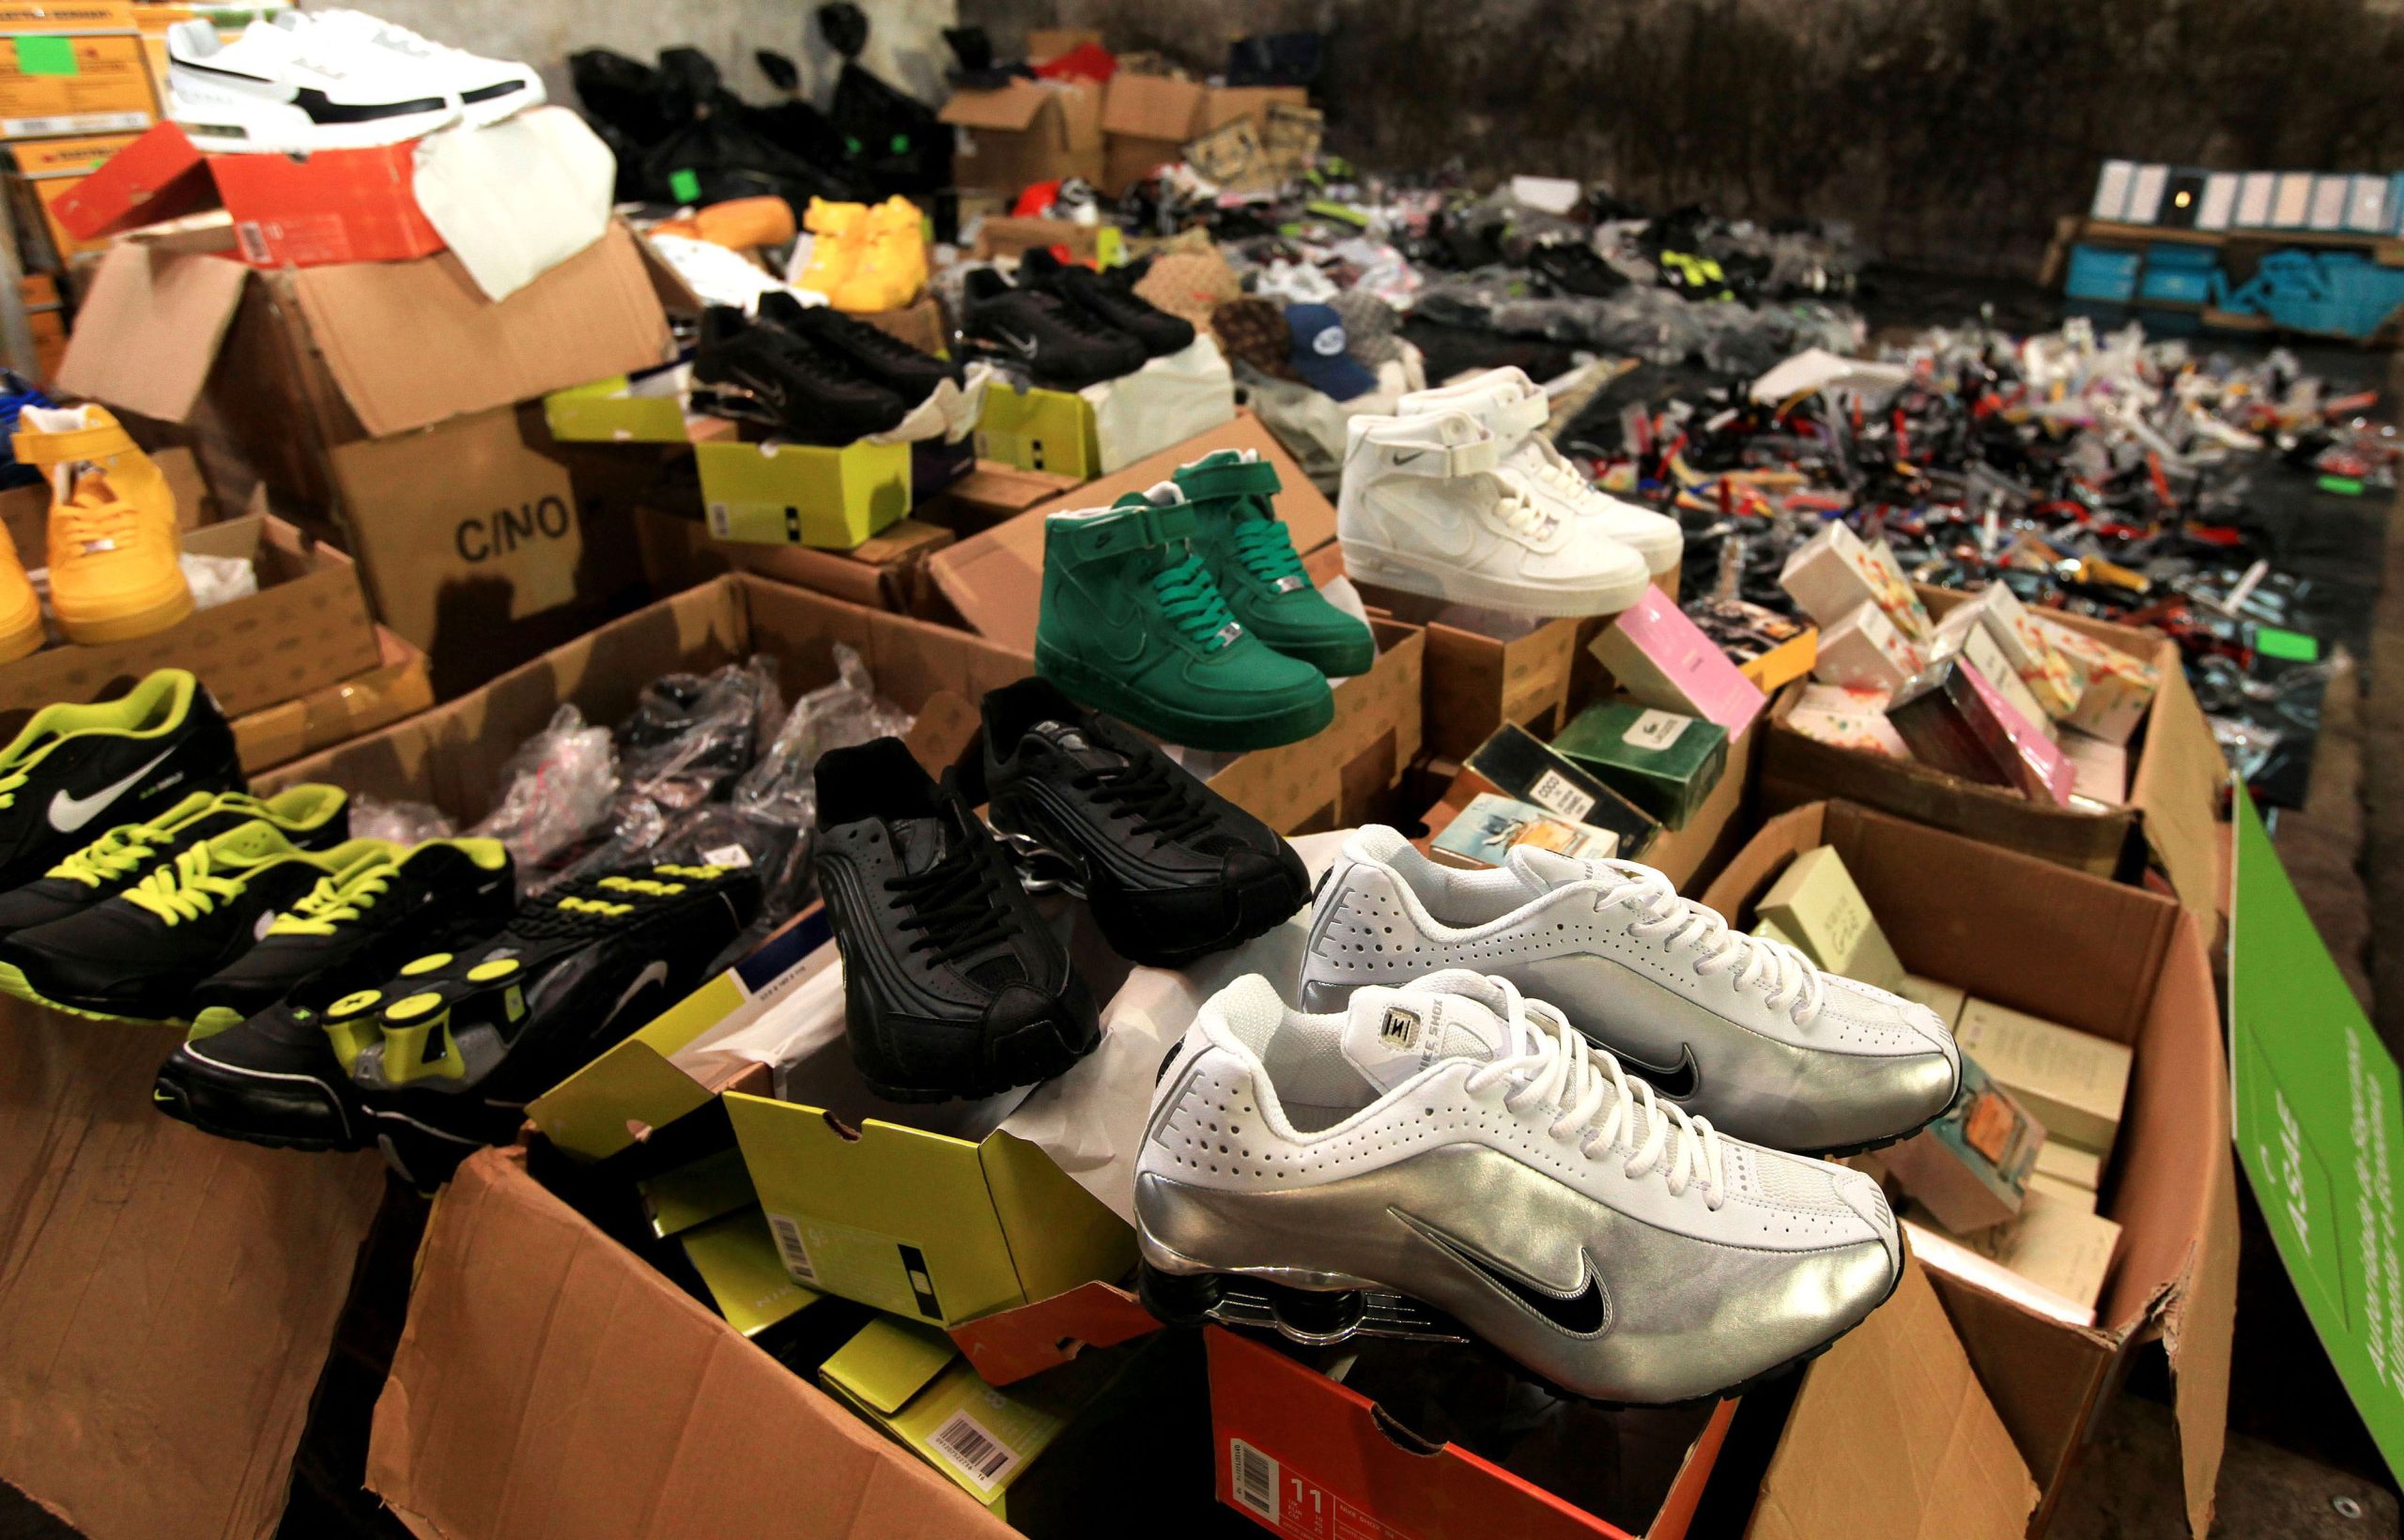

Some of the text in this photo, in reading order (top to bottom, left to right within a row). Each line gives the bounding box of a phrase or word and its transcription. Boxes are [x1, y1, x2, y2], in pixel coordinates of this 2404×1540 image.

[1538, 777, 1560, 798] COCO
[1428, 999, 1443, 1037] SHOX
[2275, 1089, 2312, 1258] ASAE
[1291, 1478, 1321, 1514] 11
